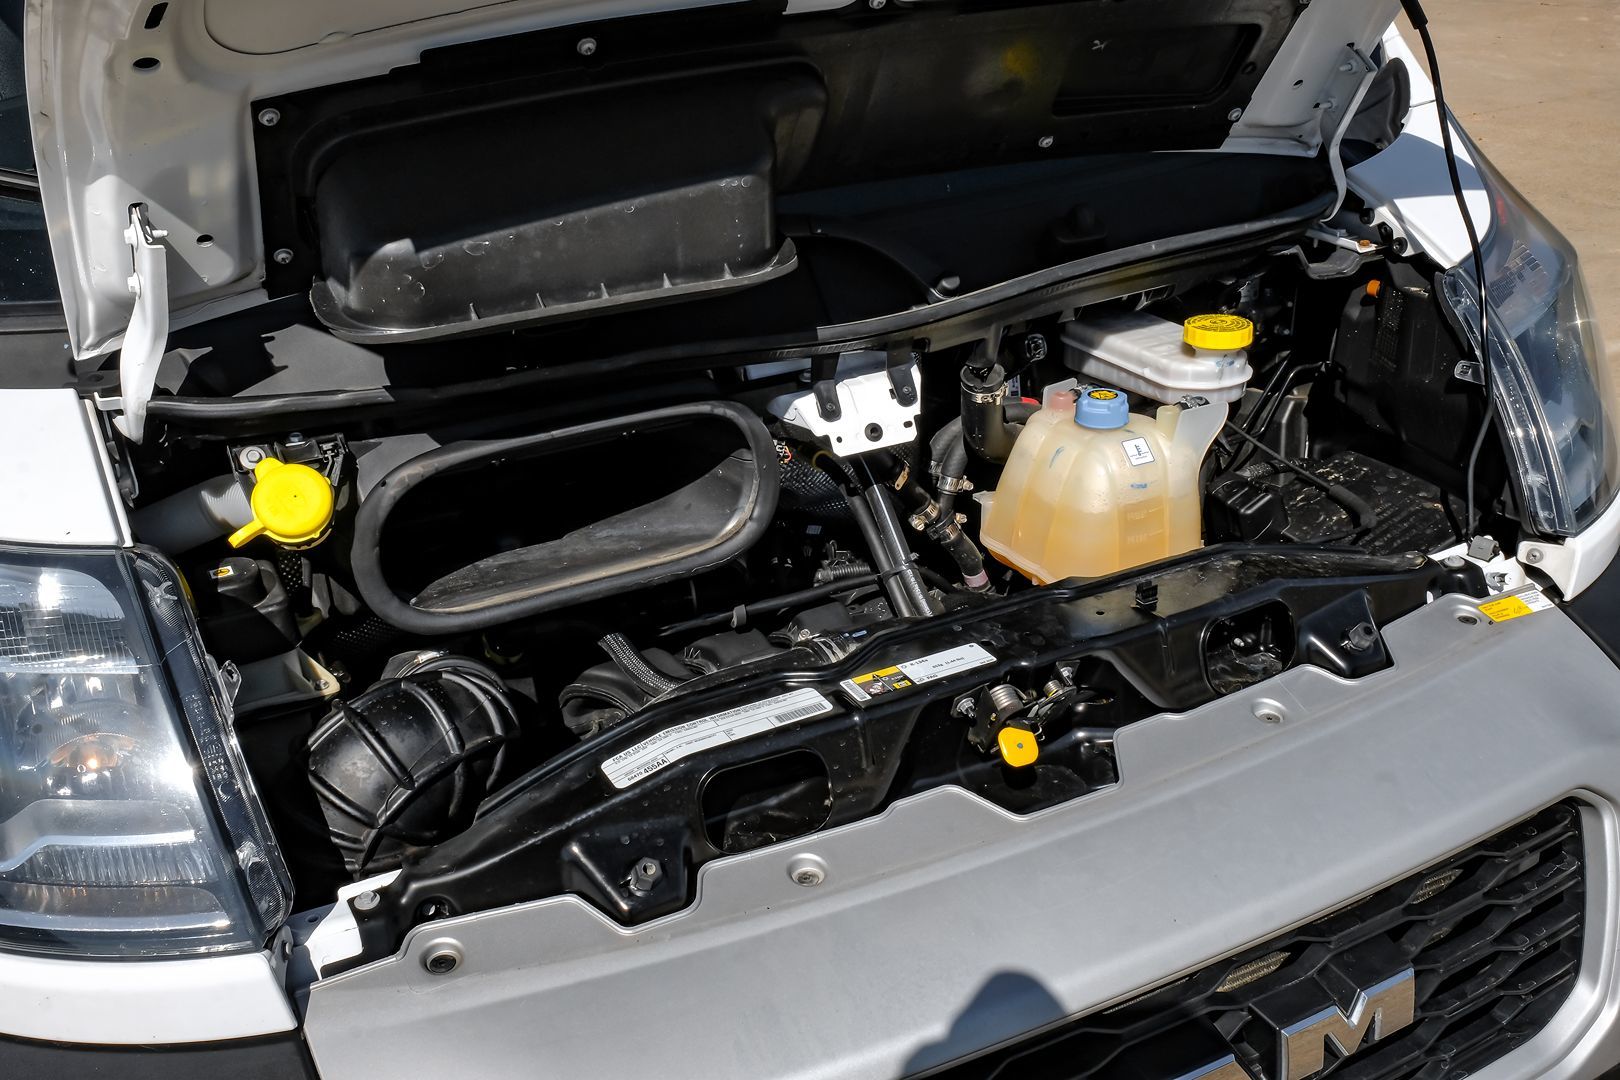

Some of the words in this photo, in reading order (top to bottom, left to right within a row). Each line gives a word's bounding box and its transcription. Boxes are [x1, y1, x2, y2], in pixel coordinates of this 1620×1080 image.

[643, 733, 662, 746] VEHICLE
[662, 723, 686, 736] EMISSION
[686, 718, 707, 728] CONTROL
[709, 708, 741, 721] INFORMATION
[612, 754, 622, 762] FCA
[643, 758, 668, 774] 455AA
